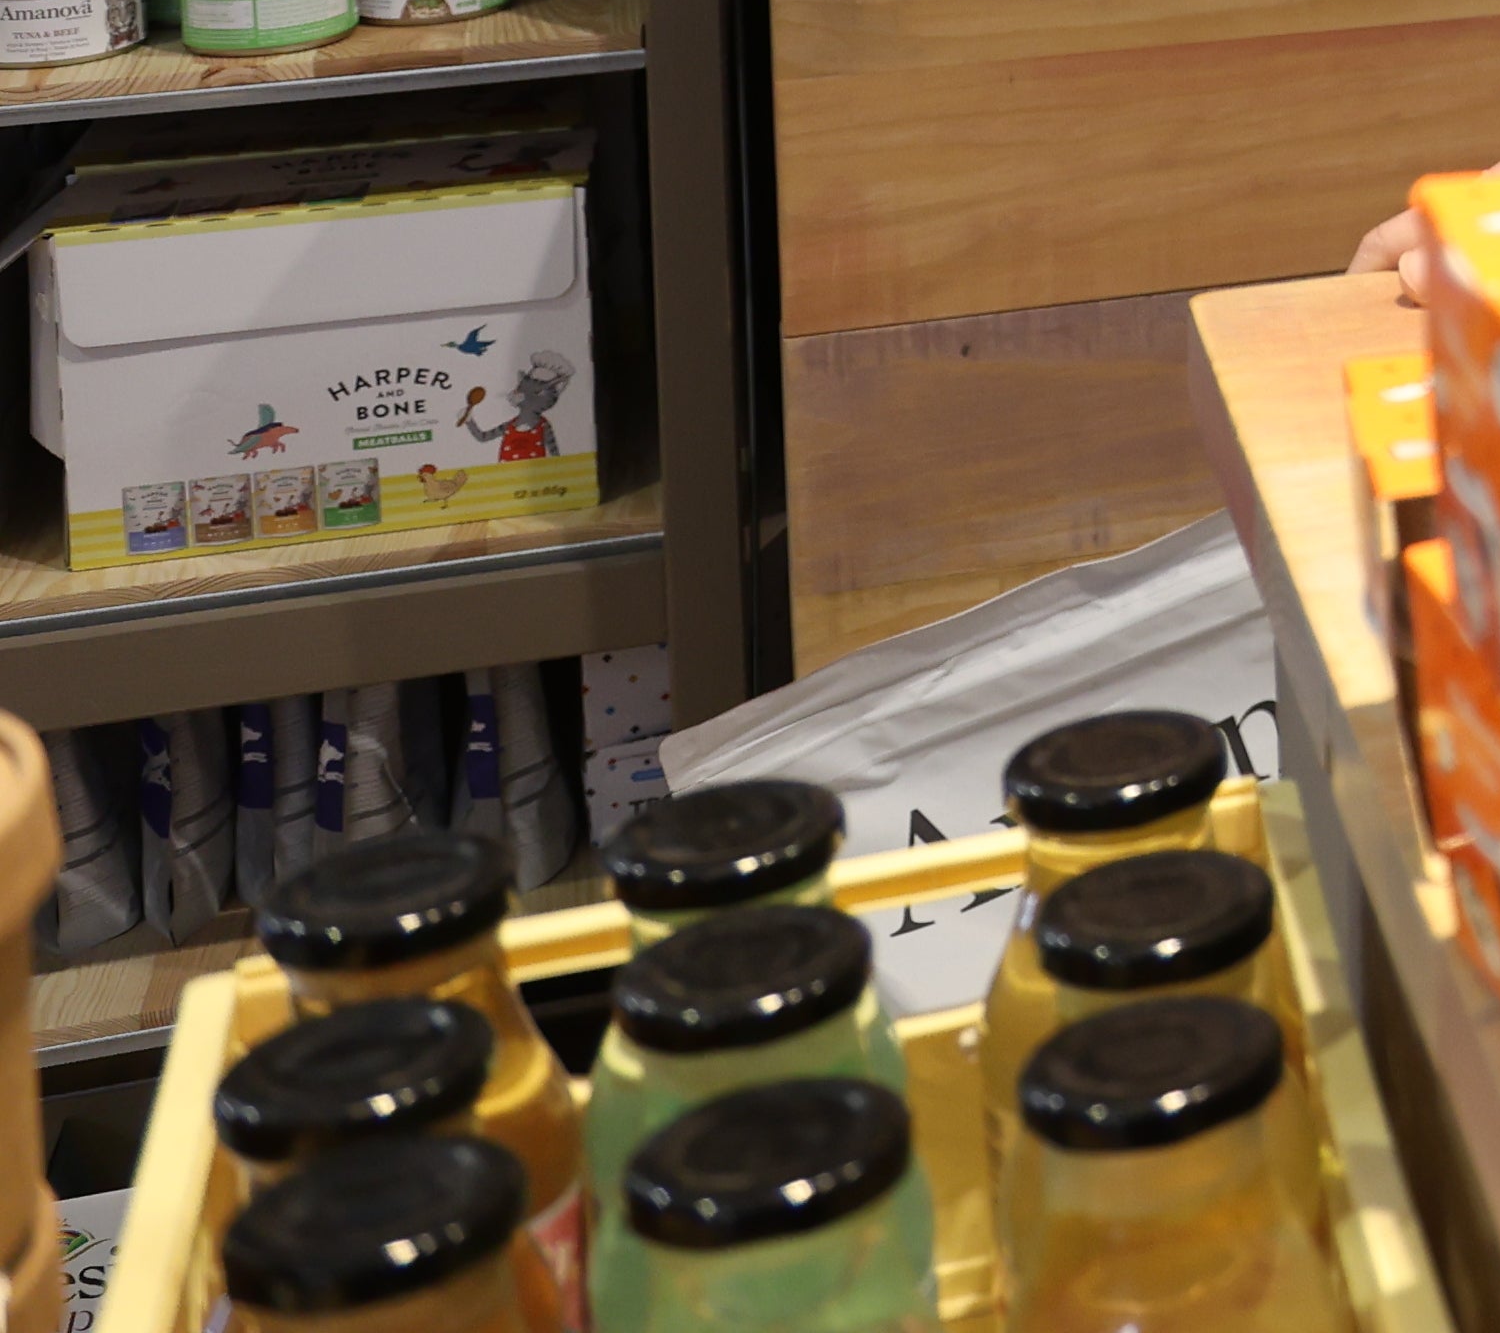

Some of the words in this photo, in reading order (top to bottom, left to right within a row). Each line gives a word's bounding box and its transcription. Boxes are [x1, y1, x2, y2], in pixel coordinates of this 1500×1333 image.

[327, 368, 453, 402] HARPER
[376, 388, 405, 400] AND
[356, 399, 427, 421] BONE
